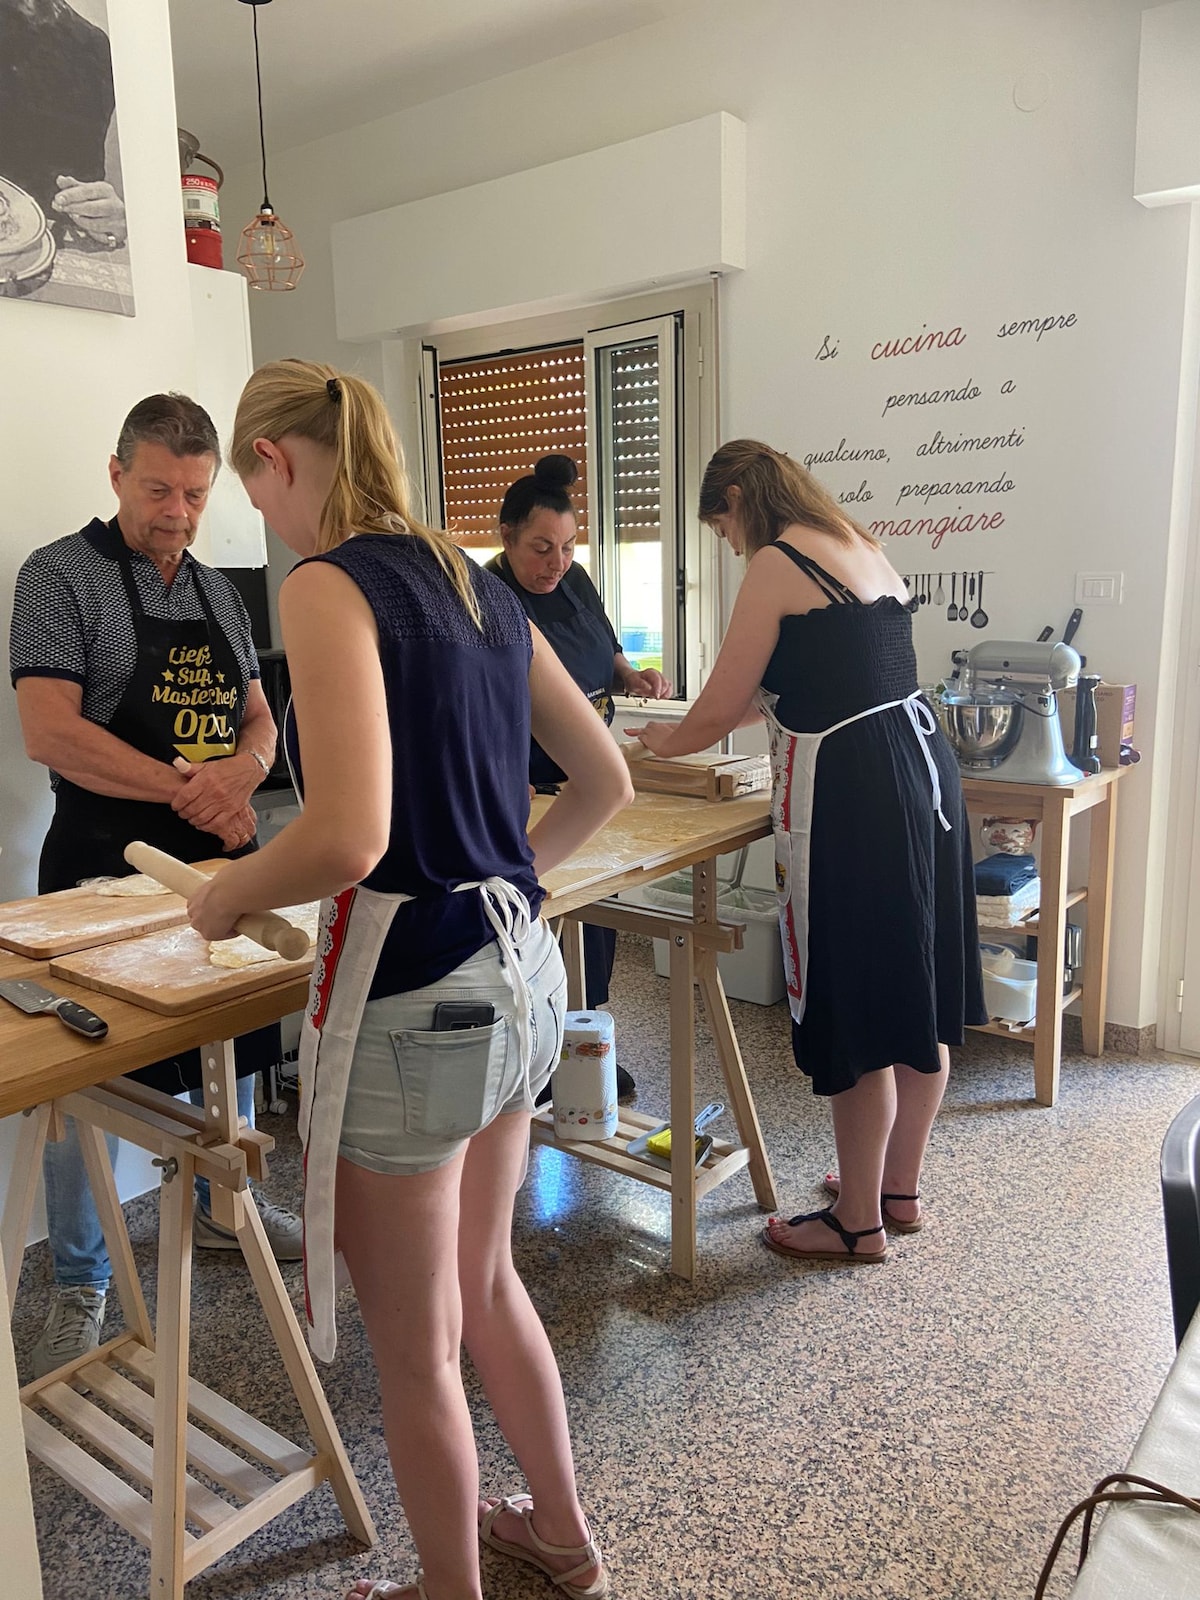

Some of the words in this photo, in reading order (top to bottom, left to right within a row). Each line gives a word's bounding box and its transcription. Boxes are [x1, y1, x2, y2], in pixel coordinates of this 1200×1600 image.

[814, 335, 840, 361] Si
[870, 323, 967, 361] cucina
[996, 313, 1078, 342] sempre
[881, 377, 982, 418] pensando
[1000, 380, 1017, 395] a
[803, 438, 891, 472] qualcuno,
[915, 426, 1027, 458] altrimenti
[837, 480, 874, 505] solo
[895, 471, 1016, 507] preparando
[868, 506, 1006, 551] mangiare
